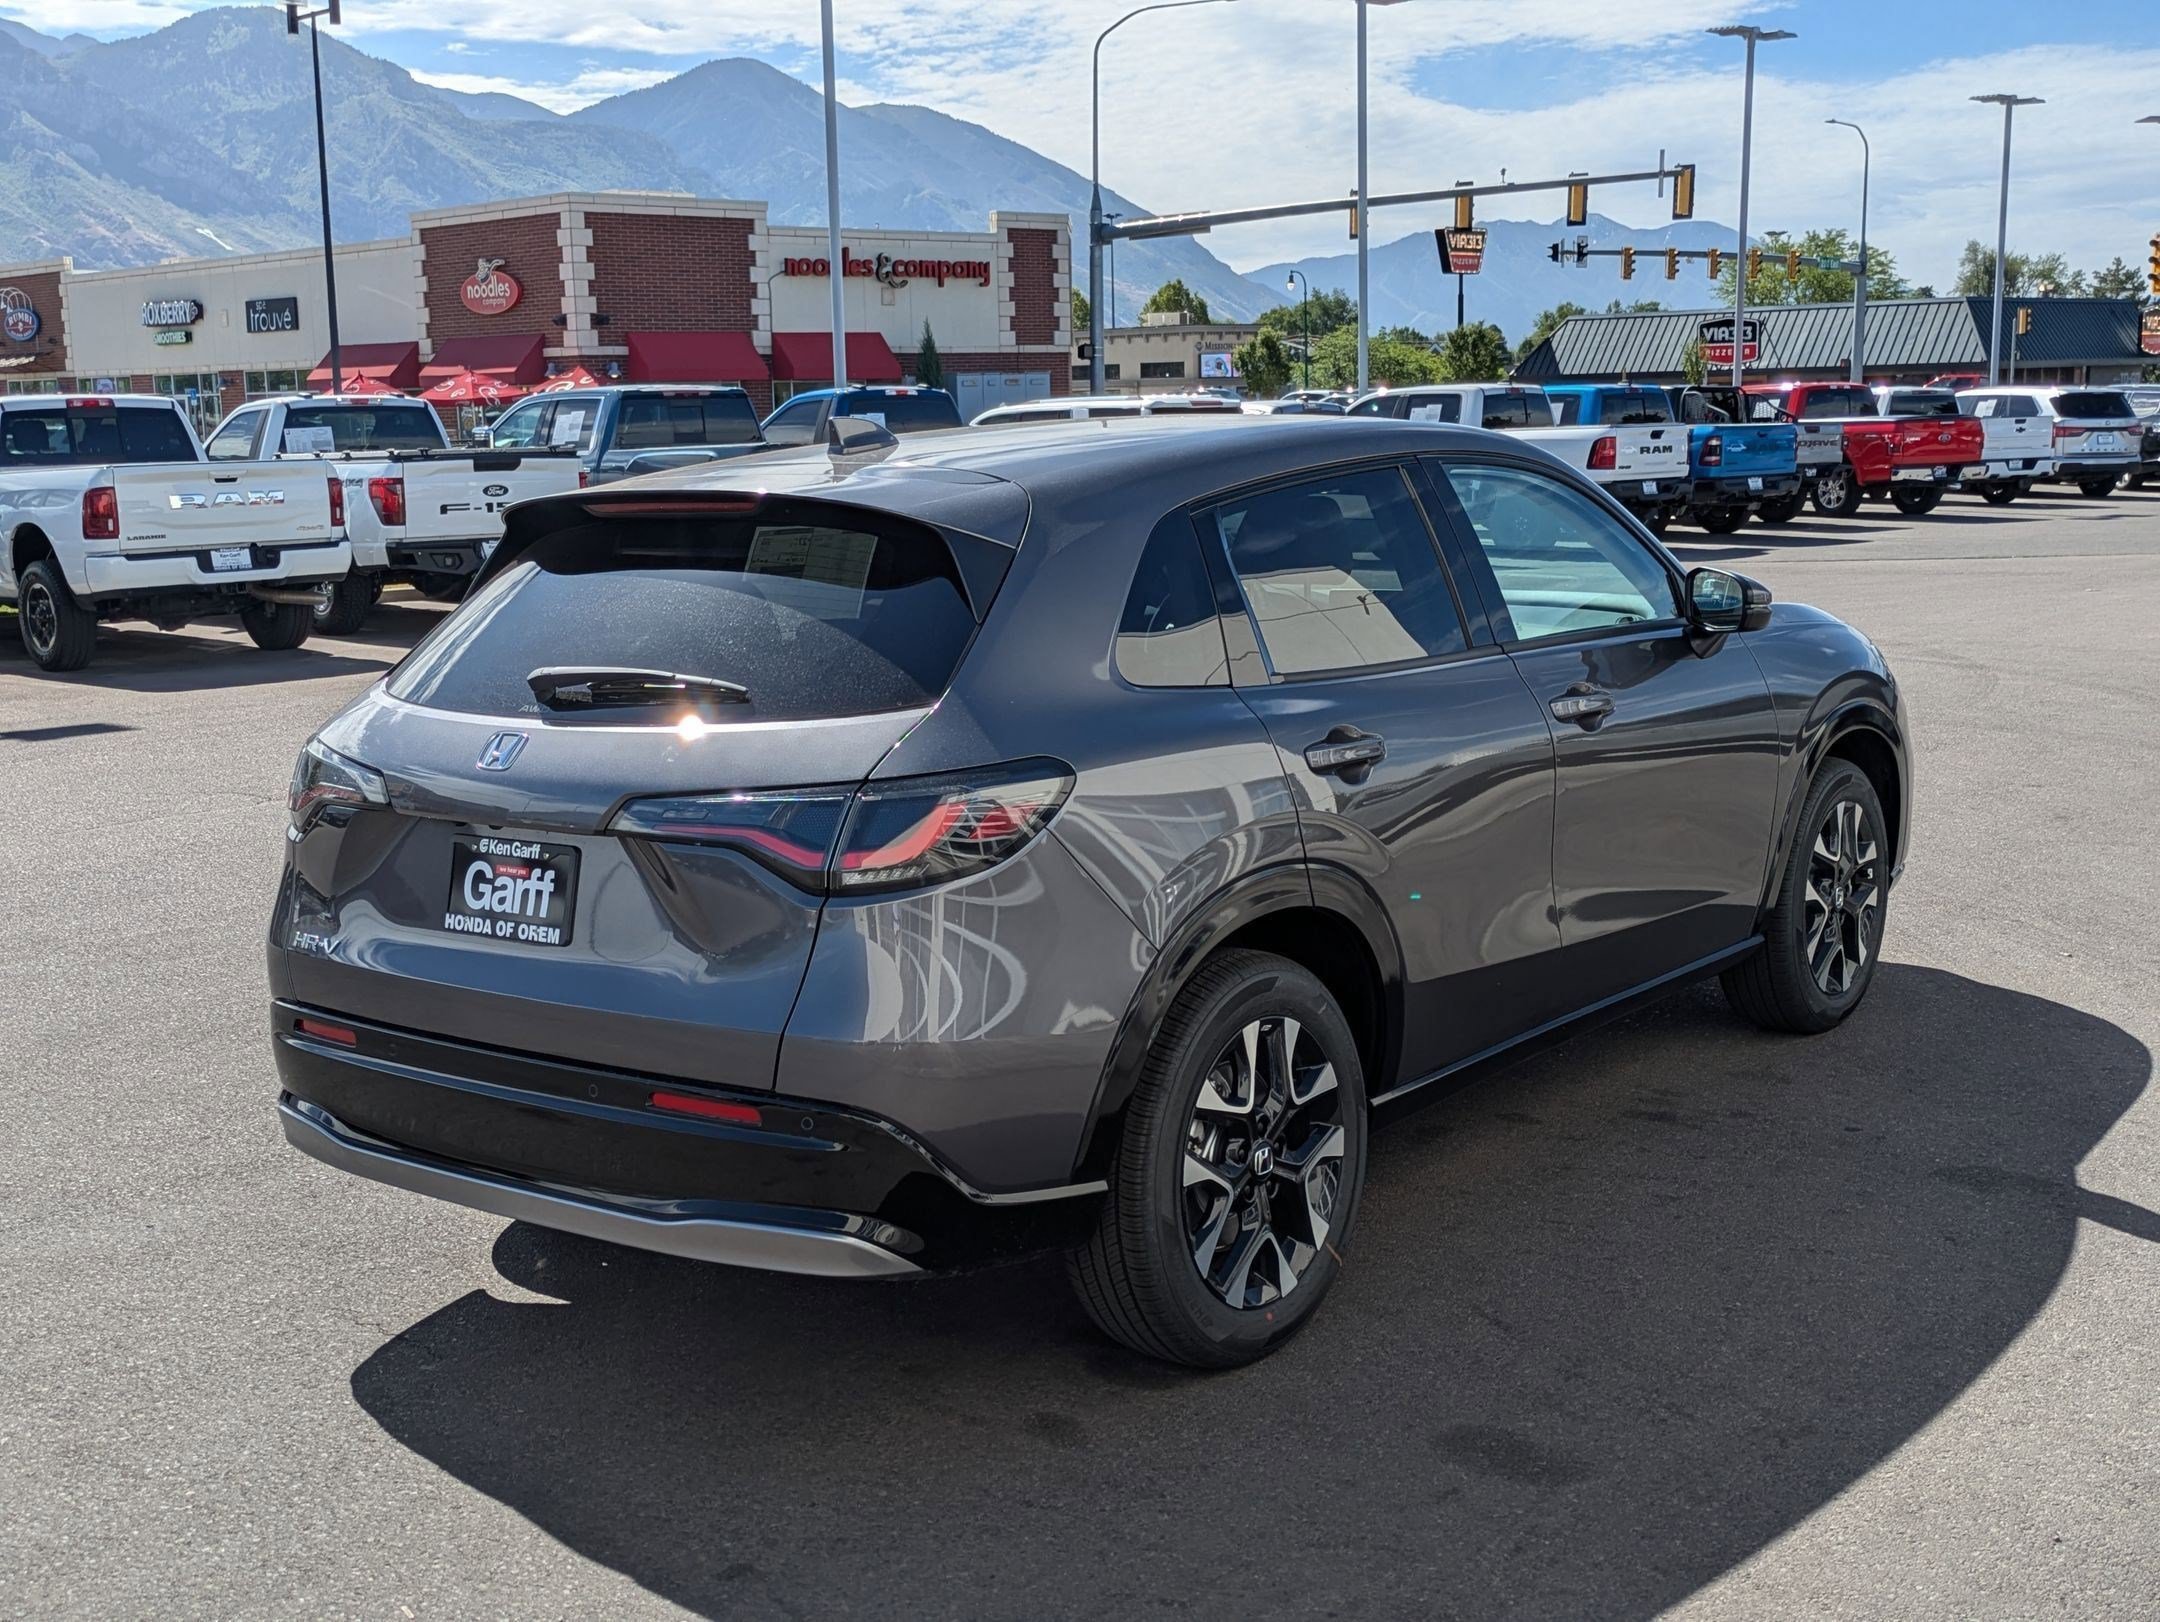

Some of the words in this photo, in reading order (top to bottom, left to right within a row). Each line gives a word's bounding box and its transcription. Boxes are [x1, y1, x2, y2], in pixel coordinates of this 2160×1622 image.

[784, 247, 874, 276] nooles
[892, 258, 990, 287] company
[467, 274, 510, 299] noodles
[482, 297, 506, 307] company
[141, 302, 191, 326] ROXBERRY
[250, 308, 292, 332] trouvé
[153, 331, 187, 344] SMOOTHIES
[1702, 326, 1753, 342] VIA33
[1640, 446, 1673, 455] RAM
[1799, 440, 1838, 449] OJAVE
[169, 490, 285, 511] RAM
[486, 486, 505, 496] Ford
[440, 502, 508, 515] F-15
[488, 839, 510, 856] Ken
[511, 842, 541, 859] Garff
[507, 866, 517, 874] hear
[464, 860, 555, 918] Garff
[444, 912, 492, 935] HONDA
[495, 920, 515, 938] OF
[518, 923, 561, 945] OREM
[293, 931, 340, 953] HR-V
